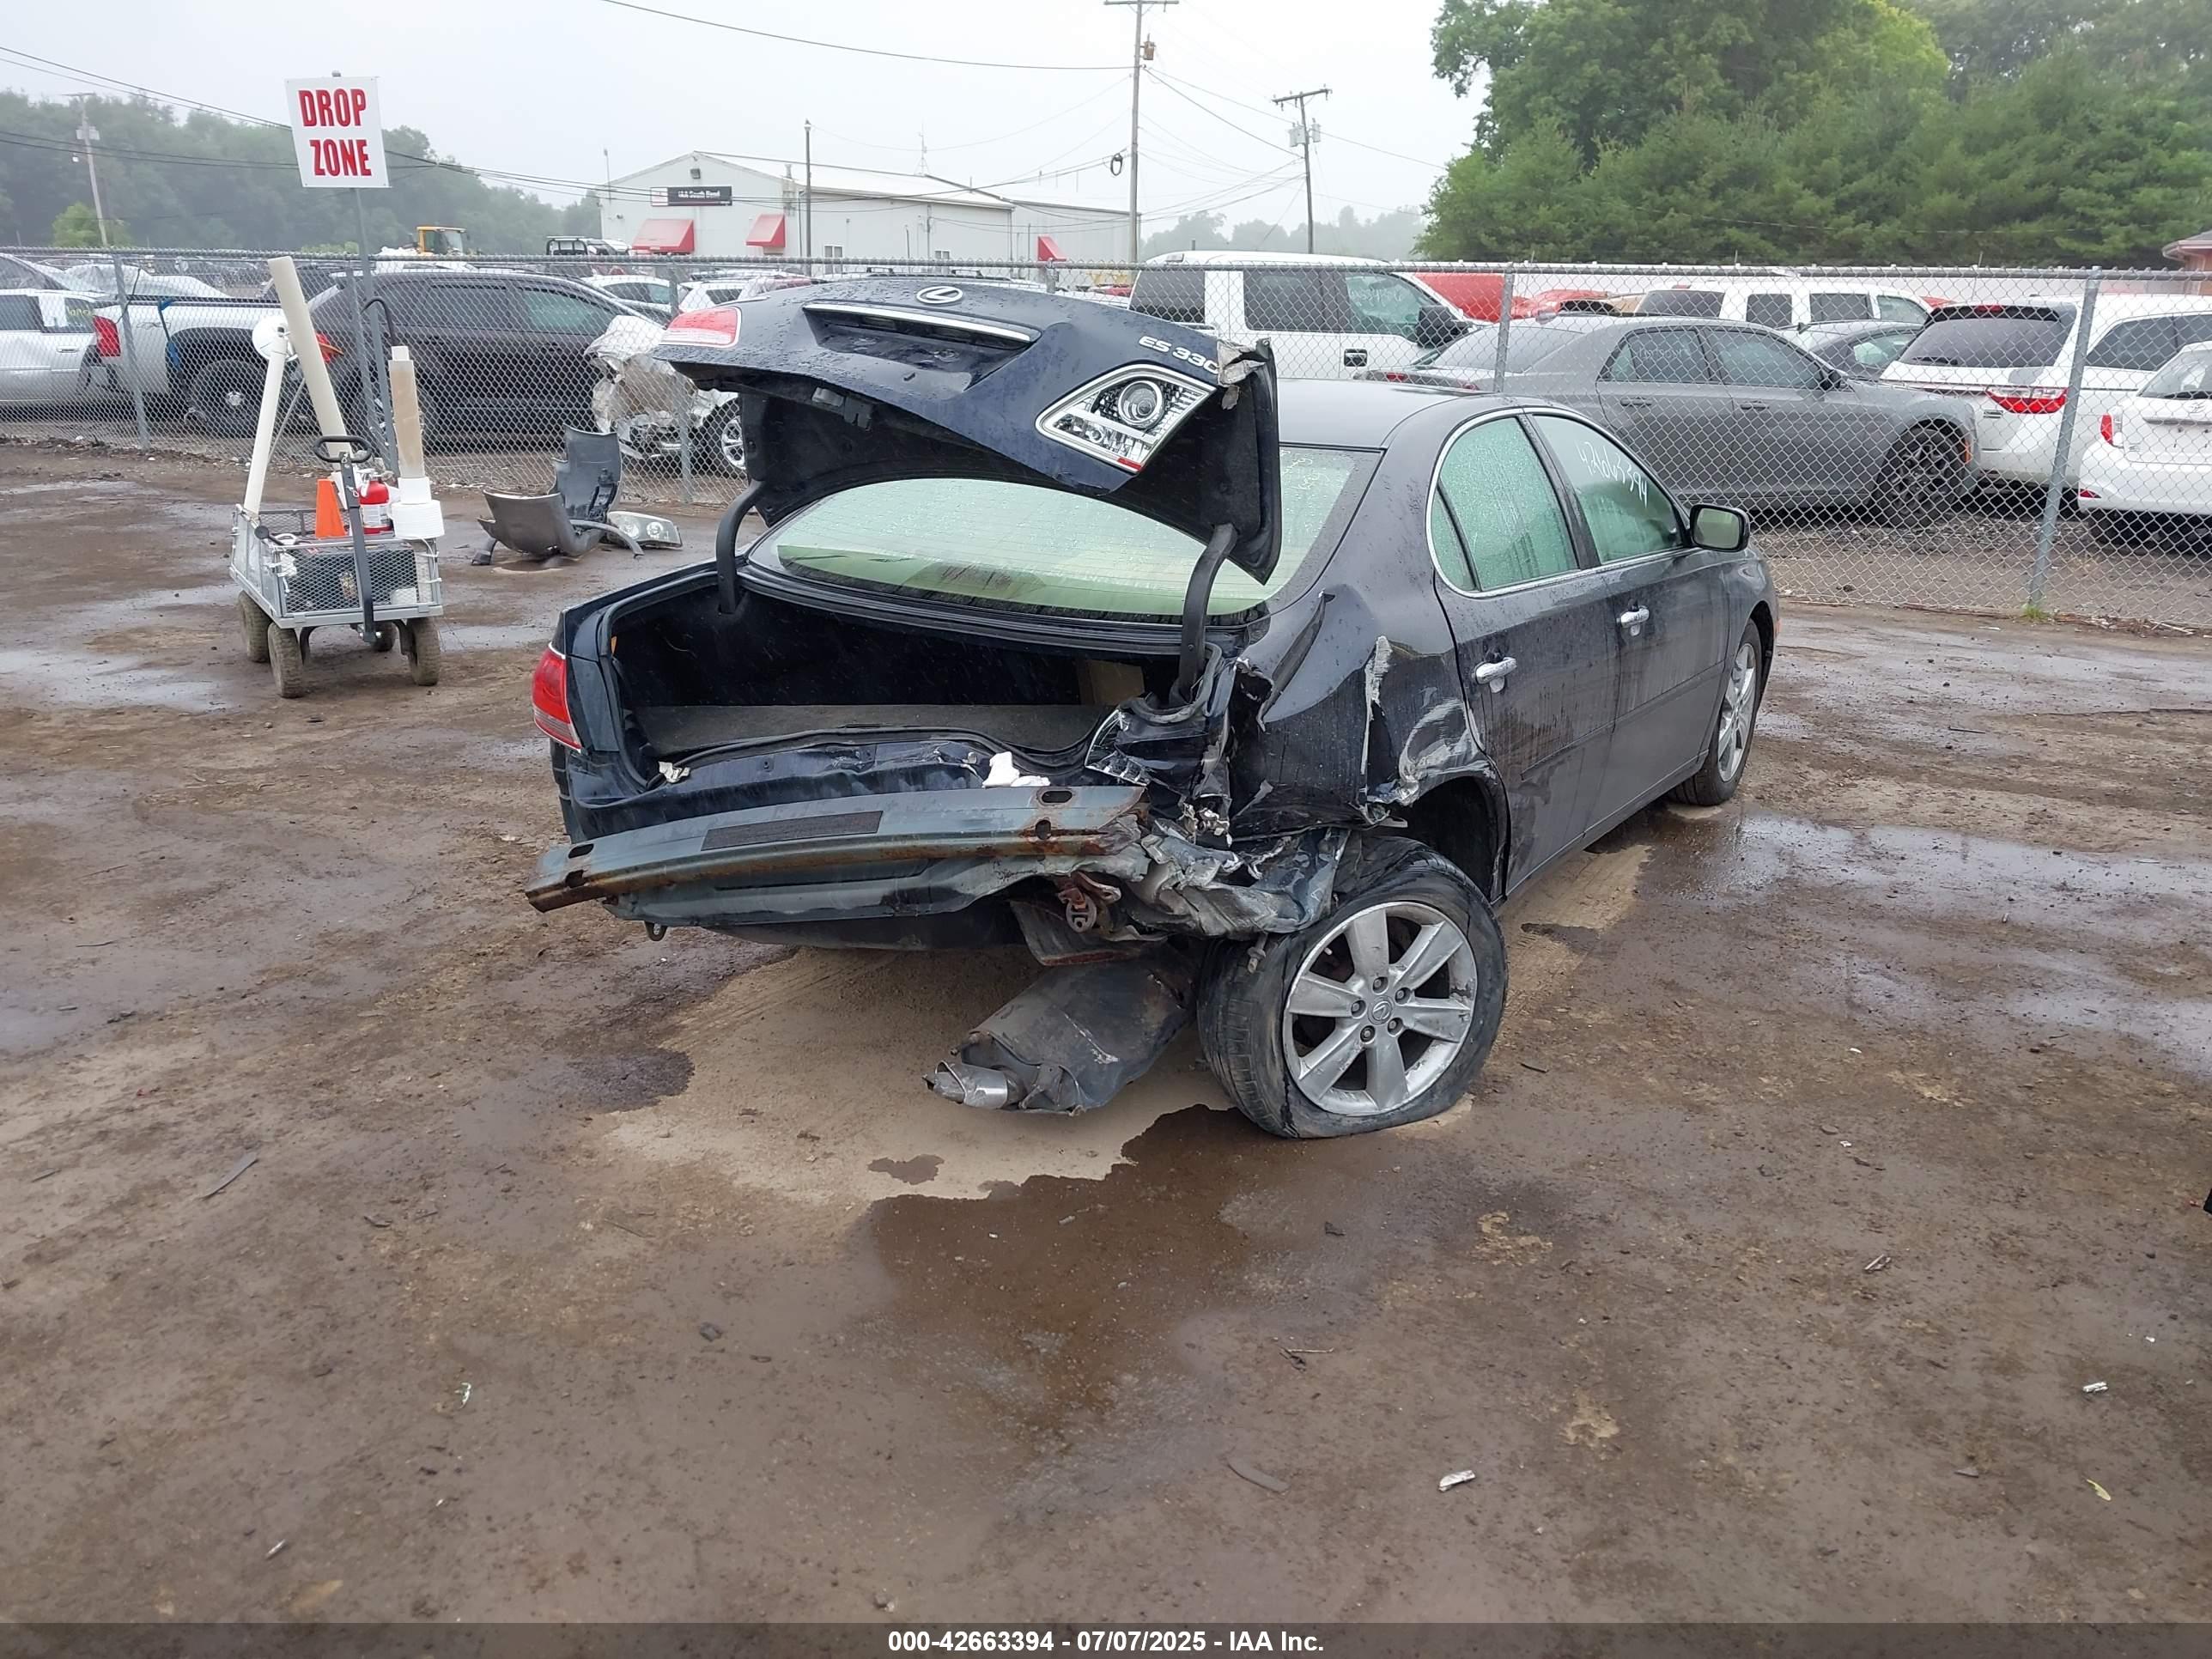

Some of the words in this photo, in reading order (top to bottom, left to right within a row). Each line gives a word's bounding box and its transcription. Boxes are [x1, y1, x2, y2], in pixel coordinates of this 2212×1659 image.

[298, 88, 367, 127] DROP
[309, 138, 372, 177] ZONE
[1138, 335, 1172, 353] ES
[1172, 346, 1219, 375] 330
[1574, 440, 1648, 508] 42663394
